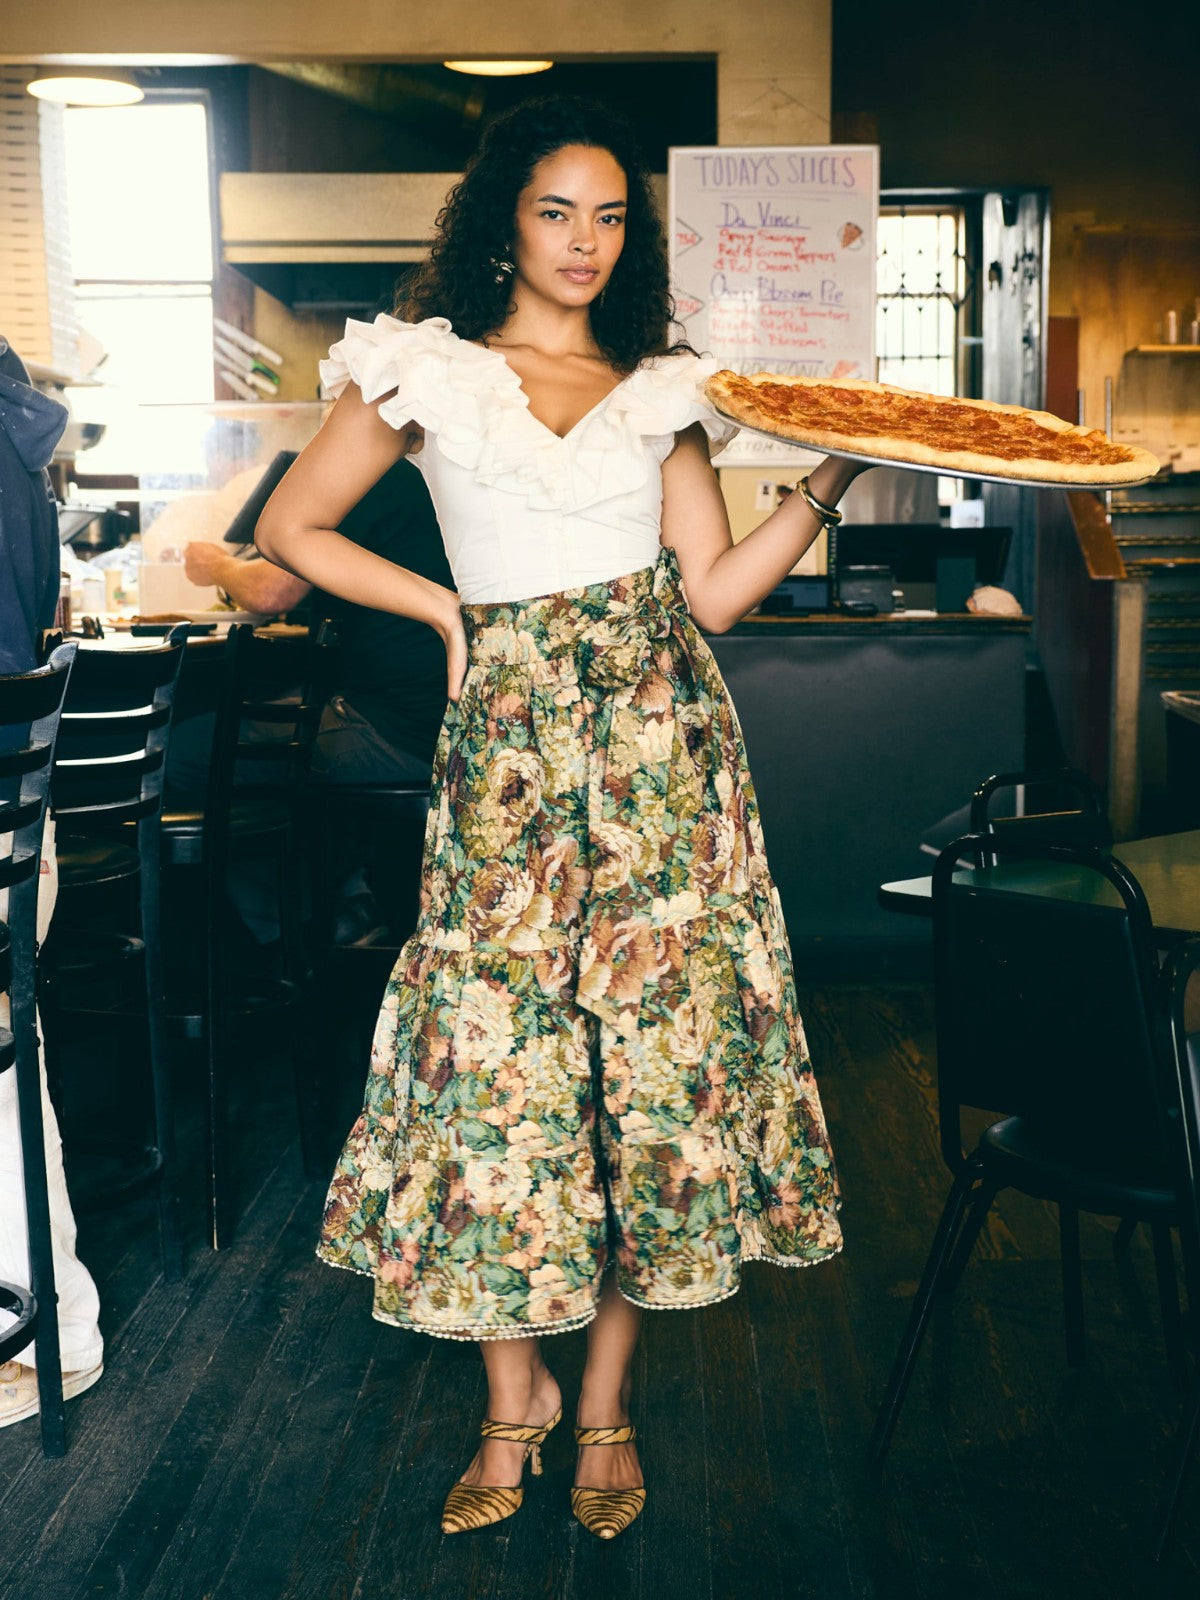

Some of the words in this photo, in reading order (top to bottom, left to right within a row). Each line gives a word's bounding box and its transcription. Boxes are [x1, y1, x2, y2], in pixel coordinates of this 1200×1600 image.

[787, 154, 856, 188] SLICES
[720, 202, 747, 226] Da
[757, 202, 800, 226] Vinci
[820, 279, 844, 303] Pie
